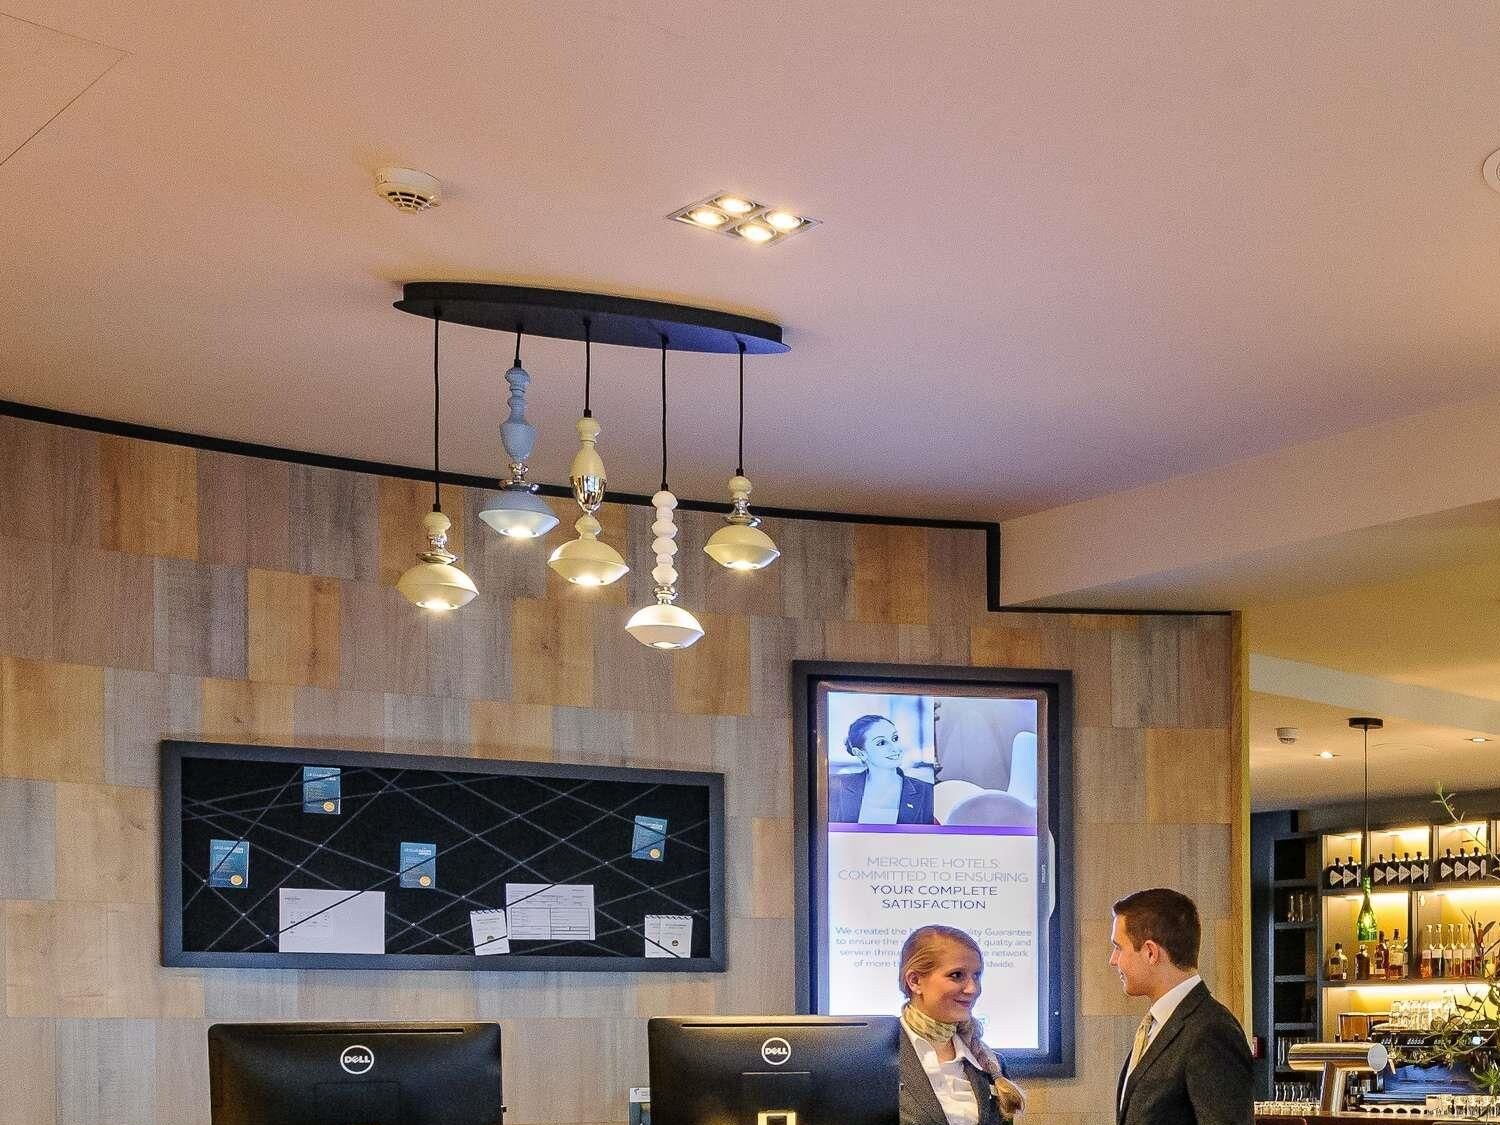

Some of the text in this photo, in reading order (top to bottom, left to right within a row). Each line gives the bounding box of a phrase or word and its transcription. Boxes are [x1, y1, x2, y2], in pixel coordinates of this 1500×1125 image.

[866, 856, 999, 869] MERCURE HOTELS
[838, 869, 927, 881] COMMITTED
[931, 871, 951, 881] TO
[955, 871, 1029, 883] ENSURING
[870, 885, 998, 896] YOUR COMPLETE
[882, 899, 986, 910] SATISFACTION
[835, 927, 852, 935] We
[854, 927, 890, 935] created
[891, 927, 907, 935] the
[985, 928, 1032, 936] Guarantee
[984, 938, 1013, 948] quality
[764, 1047, 788, 1055] DELL
[344, 1055, 371, 1064] DELL
